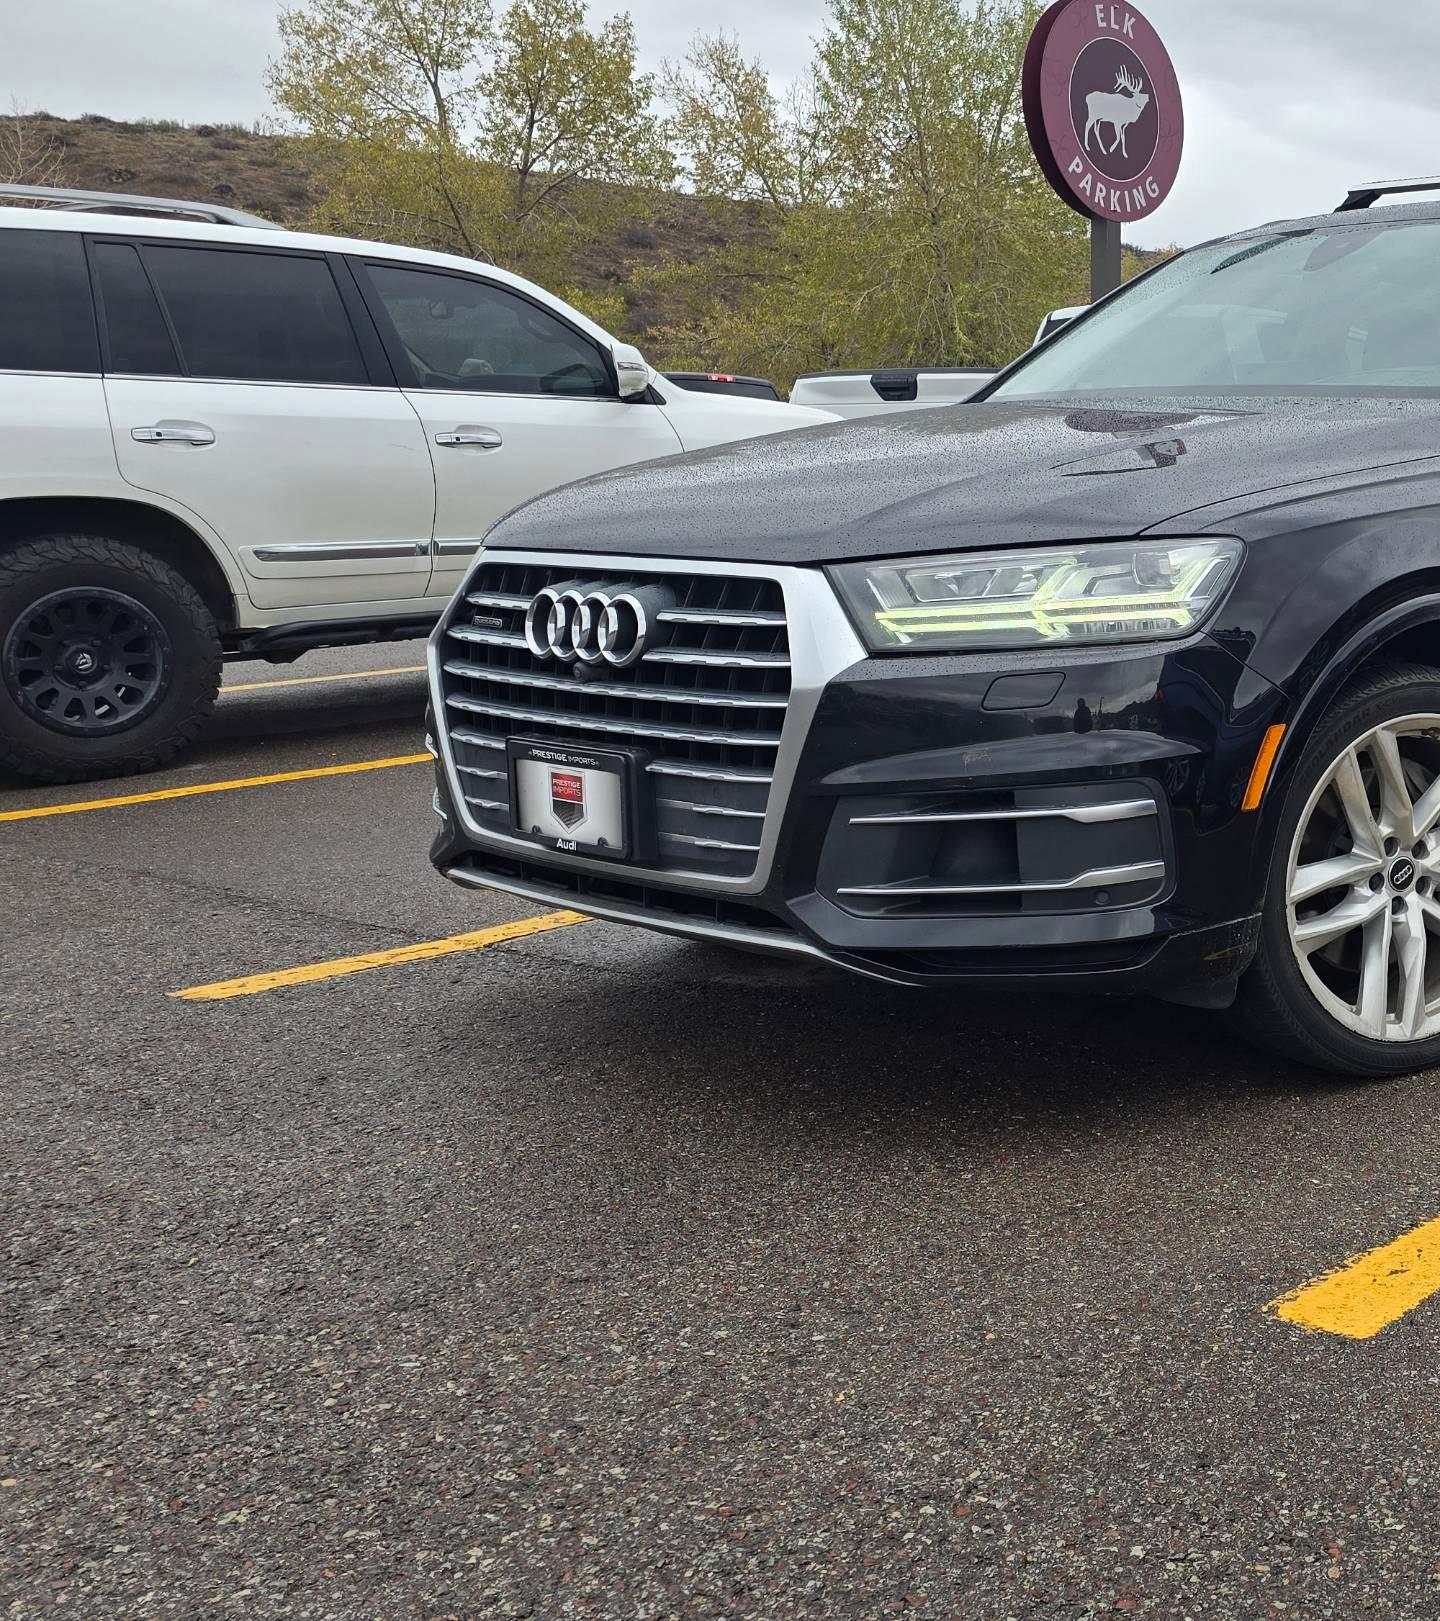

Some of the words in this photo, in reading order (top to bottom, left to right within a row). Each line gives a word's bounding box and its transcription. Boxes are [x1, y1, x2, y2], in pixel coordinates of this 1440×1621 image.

[1095, 4, 1136, 40] ELK
[1068, 156, 1160, 213] PARKING
[532, 749, 567, 762] PRESTIGE
[567, 755, 596, 765] IMPORTS
[552, 778, 581, 789] PRESTIGE
[553, 785, 581, 797] IMPORTS
[556, 838, 577, 851] Audi
